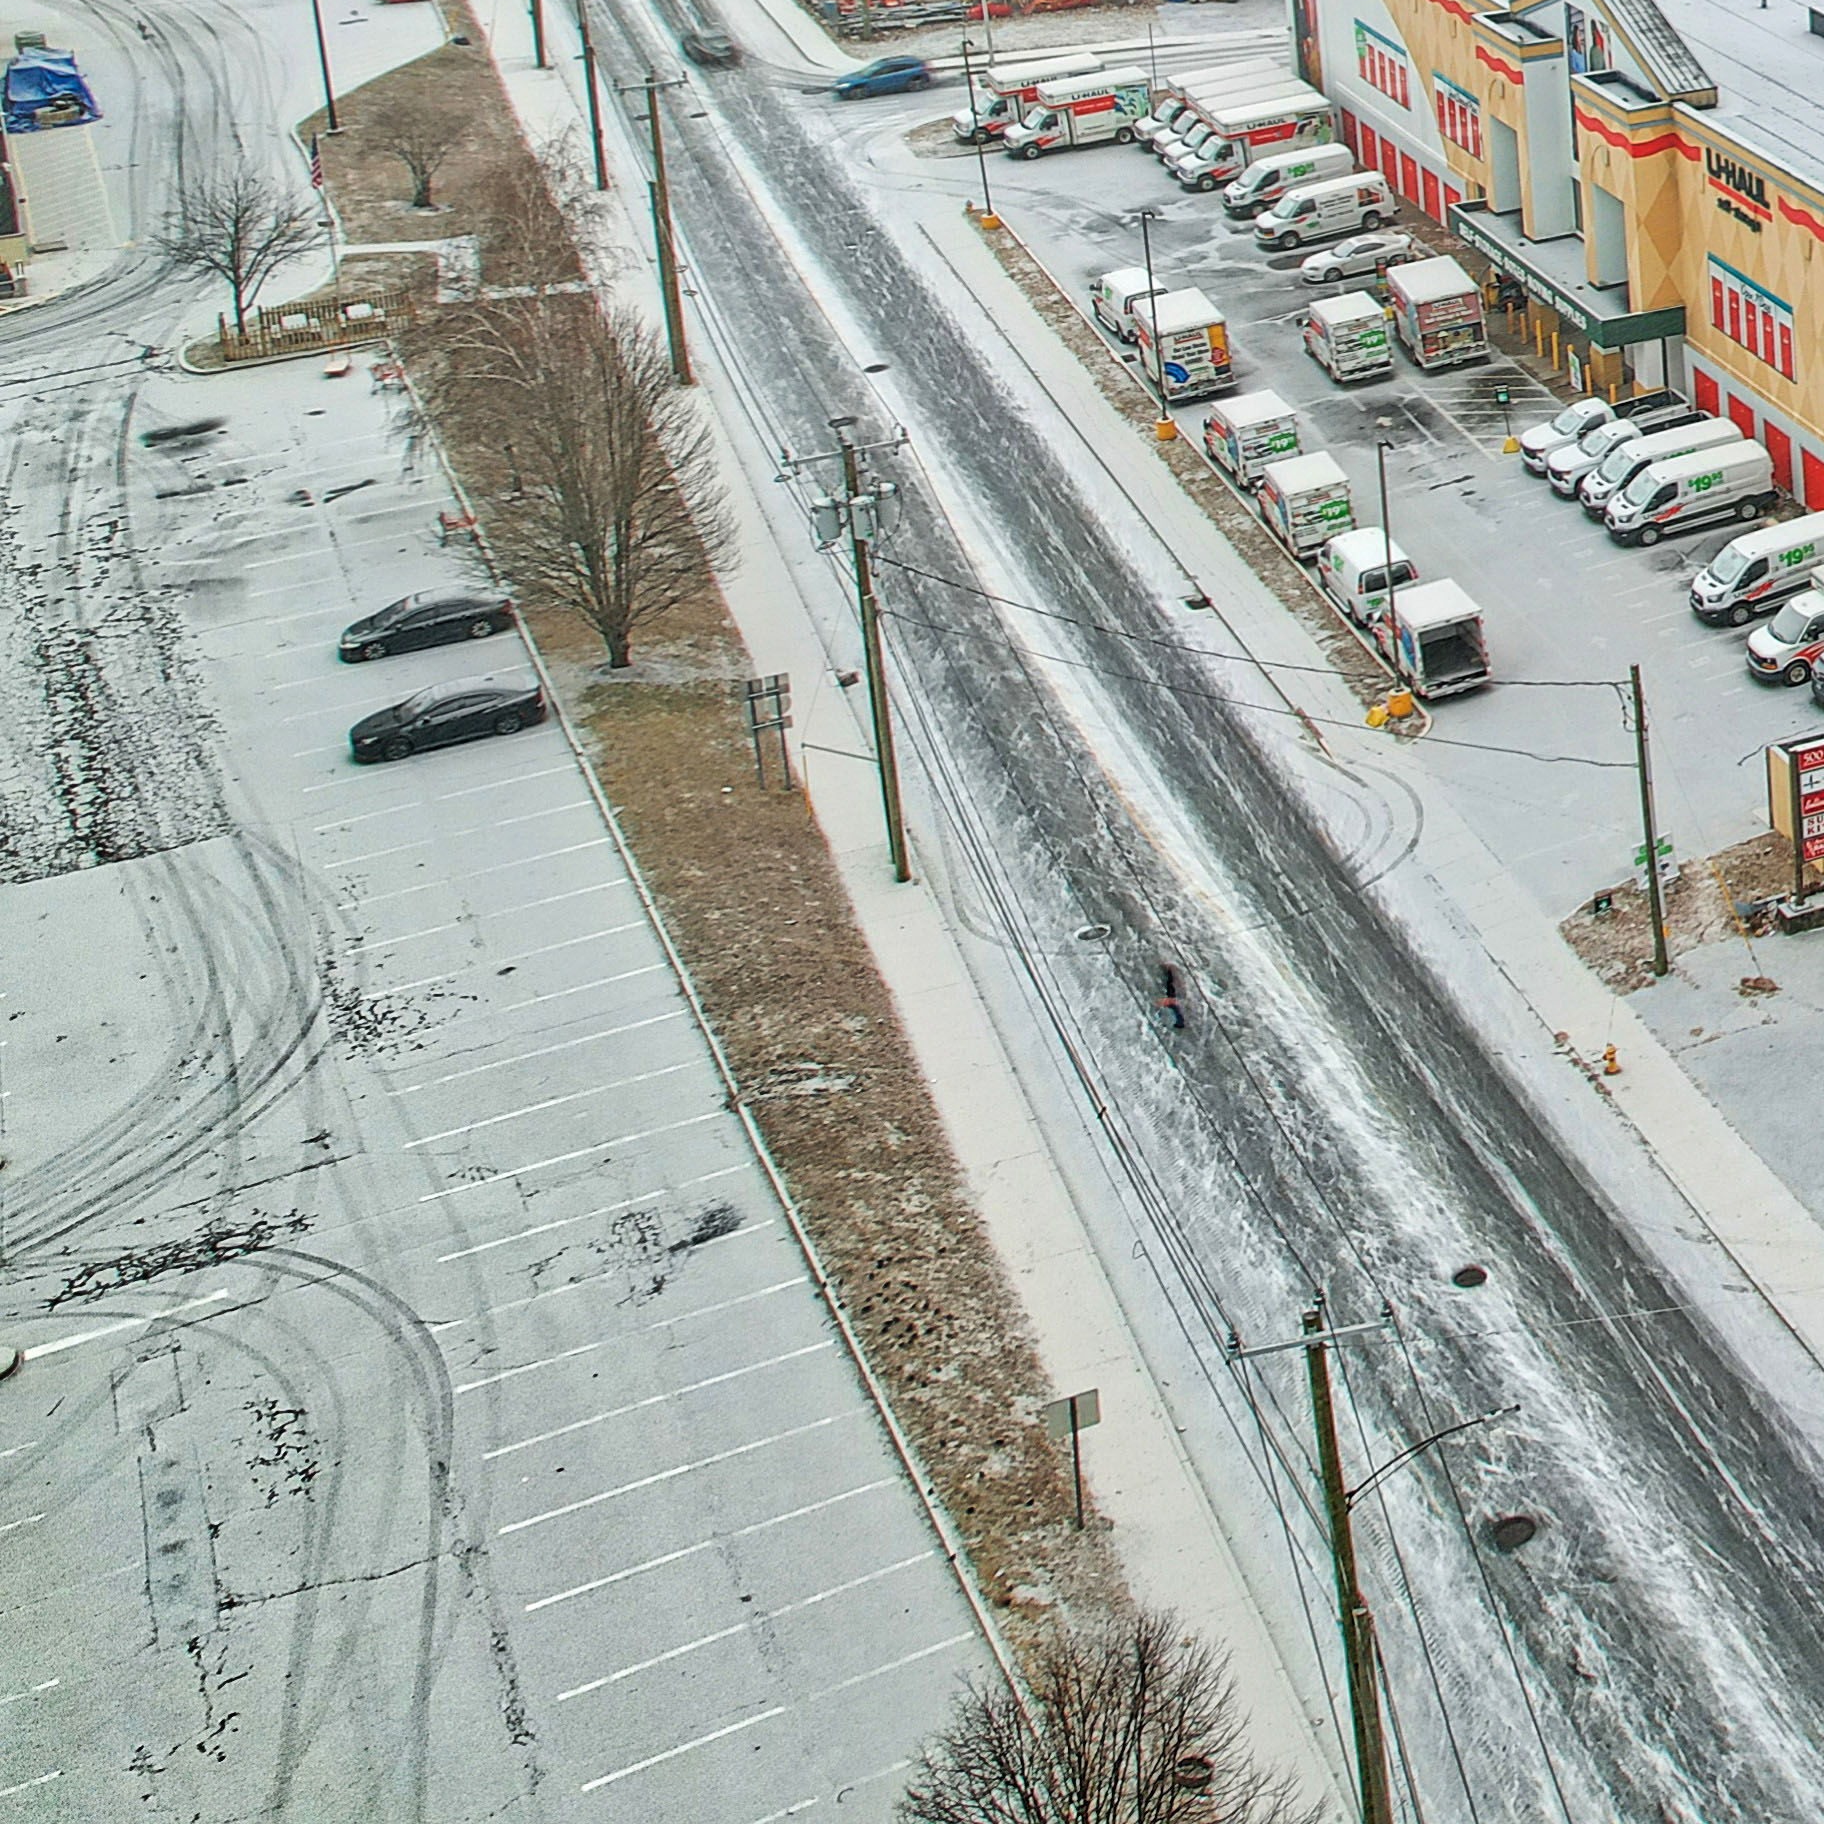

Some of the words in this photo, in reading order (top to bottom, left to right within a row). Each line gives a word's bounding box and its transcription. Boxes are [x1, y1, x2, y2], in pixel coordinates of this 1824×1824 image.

[1072, 88, 1110, 101] U-HAUL
[1247, 117, 1286, 131] U-HAUL
[1706, 147, 1771, 210] U-HAUL
[1803, 749, 1824, 763] 500
